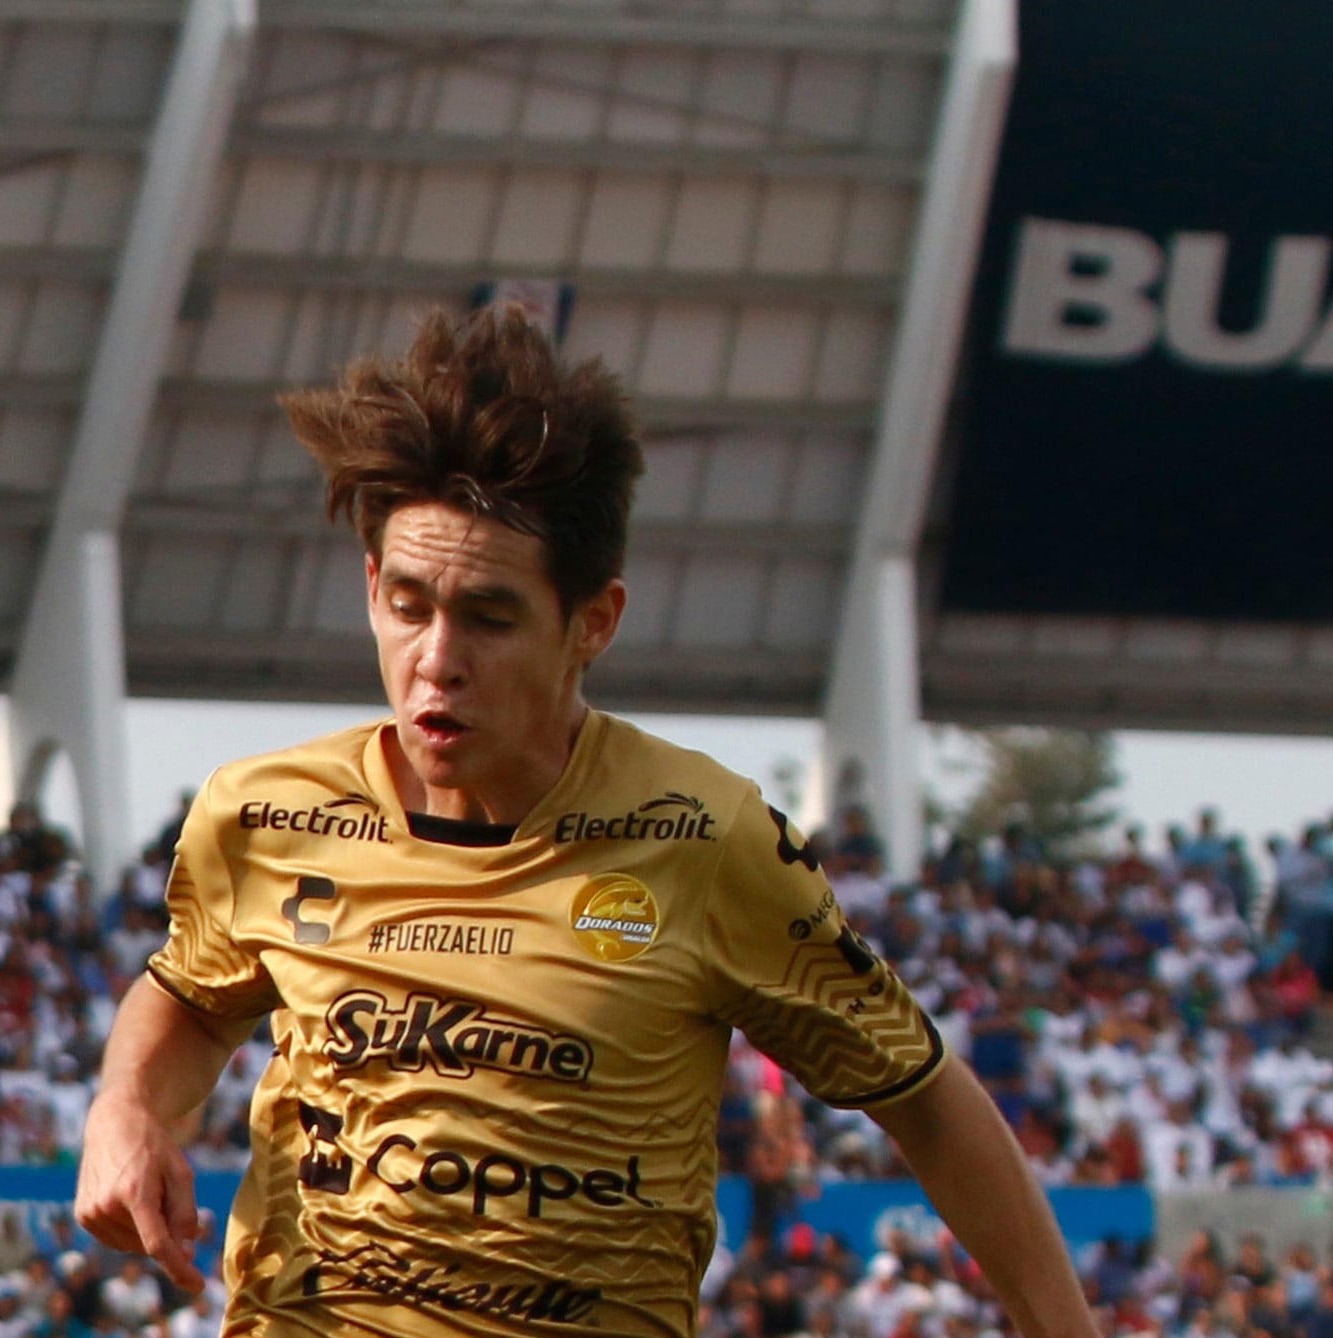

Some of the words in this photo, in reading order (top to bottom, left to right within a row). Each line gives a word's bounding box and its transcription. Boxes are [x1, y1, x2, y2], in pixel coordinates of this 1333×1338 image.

[1001, 216, 1333, 373] BU
[240, 801, 393, 844] Electrolit
[555, 811, 716, 843] Electrolit
[367, 924, 515, 955] #FUERZAELIO
[575, 915, 655, 934] DORADOS
[324, 992, 593, 1081] SuKarne
[367, 1133, 656, 1218] Coppel
